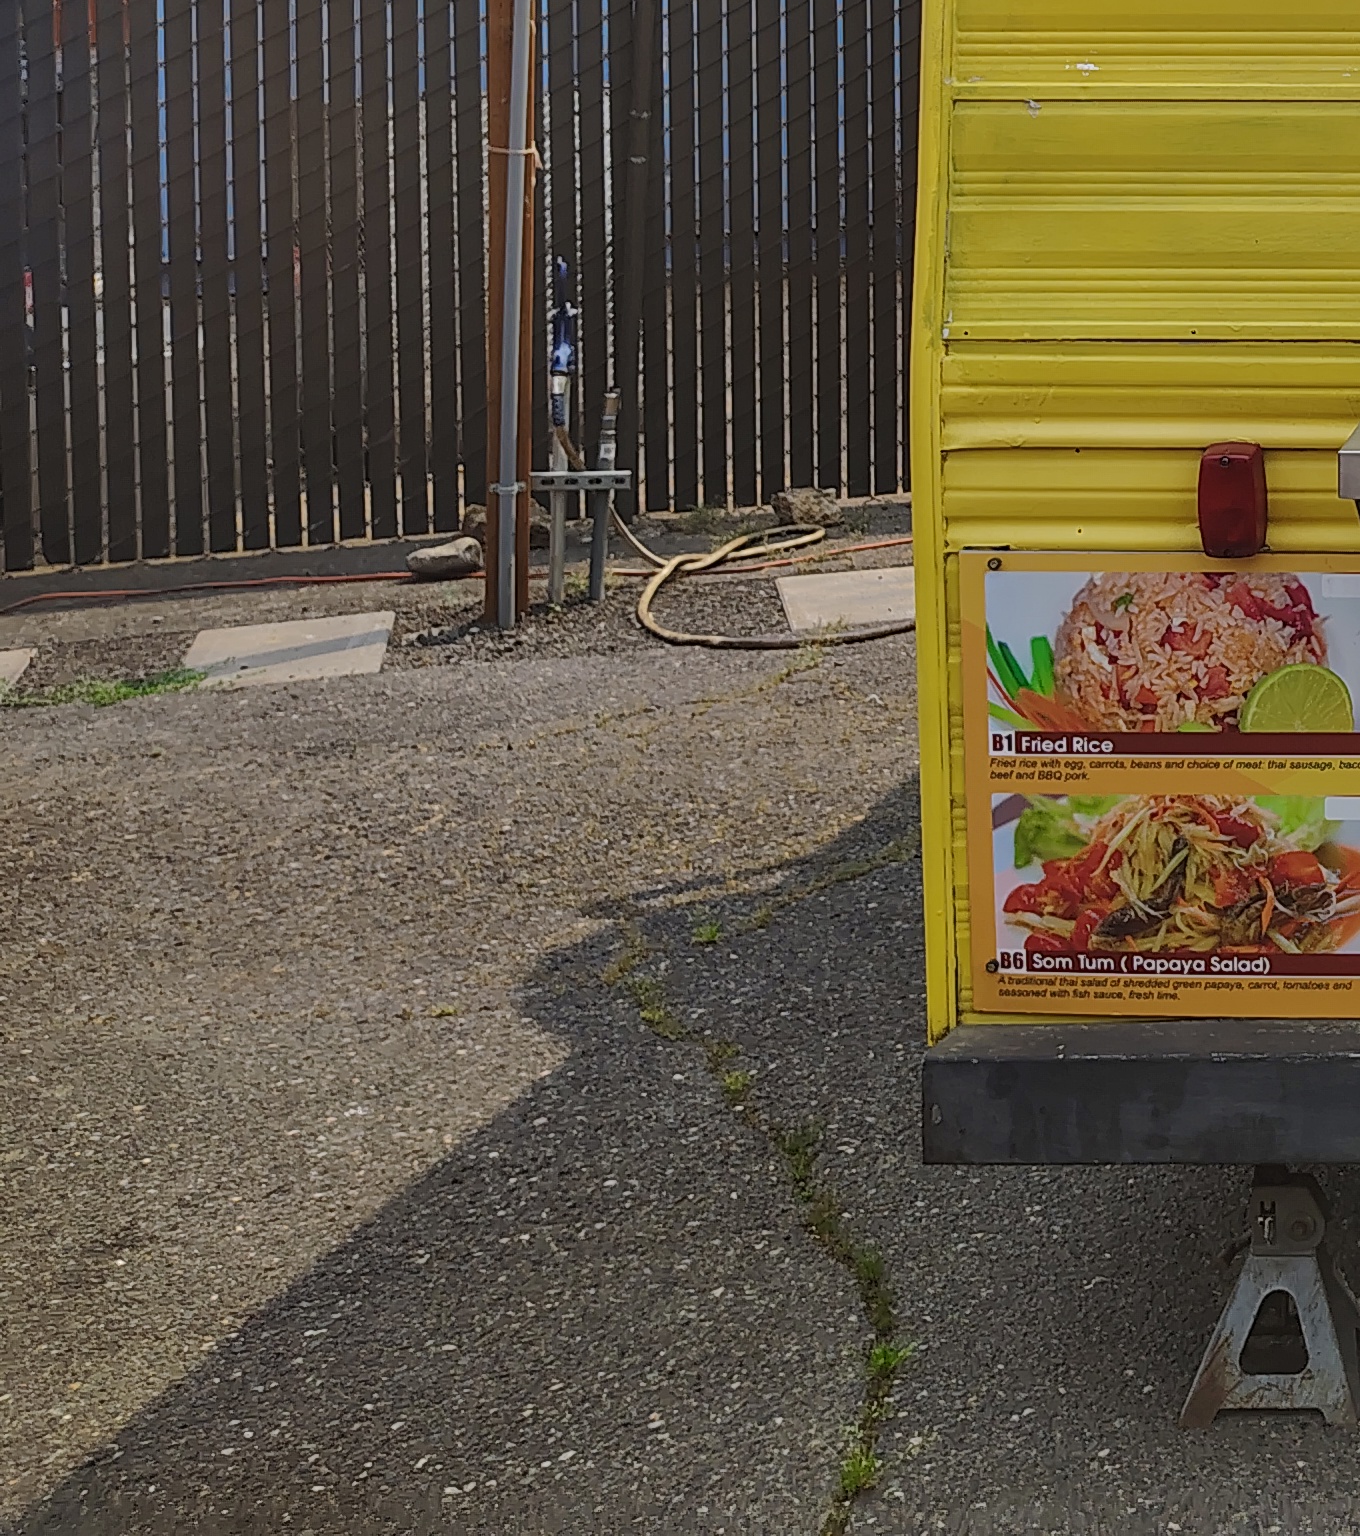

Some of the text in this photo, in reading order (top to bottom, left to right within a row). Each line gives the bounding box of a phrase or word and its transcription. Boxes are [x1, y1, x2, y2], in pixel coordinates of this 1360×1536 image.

[992, 736, 1113, 753] B1 Fried Rice
[990, 770, 1013, 780] beef
[1015, 770, 1034, 781] and
[1038, 770, 1063, 782] BBQ
[1001, 952, 1023, 969] B6
[1033, 954, 1074, 970] Som
[1079, 955, 1114, 971] Tum
[1134, 956, 1205, 975] Papaya
[1211, 957, 1270, 974] Salad)
